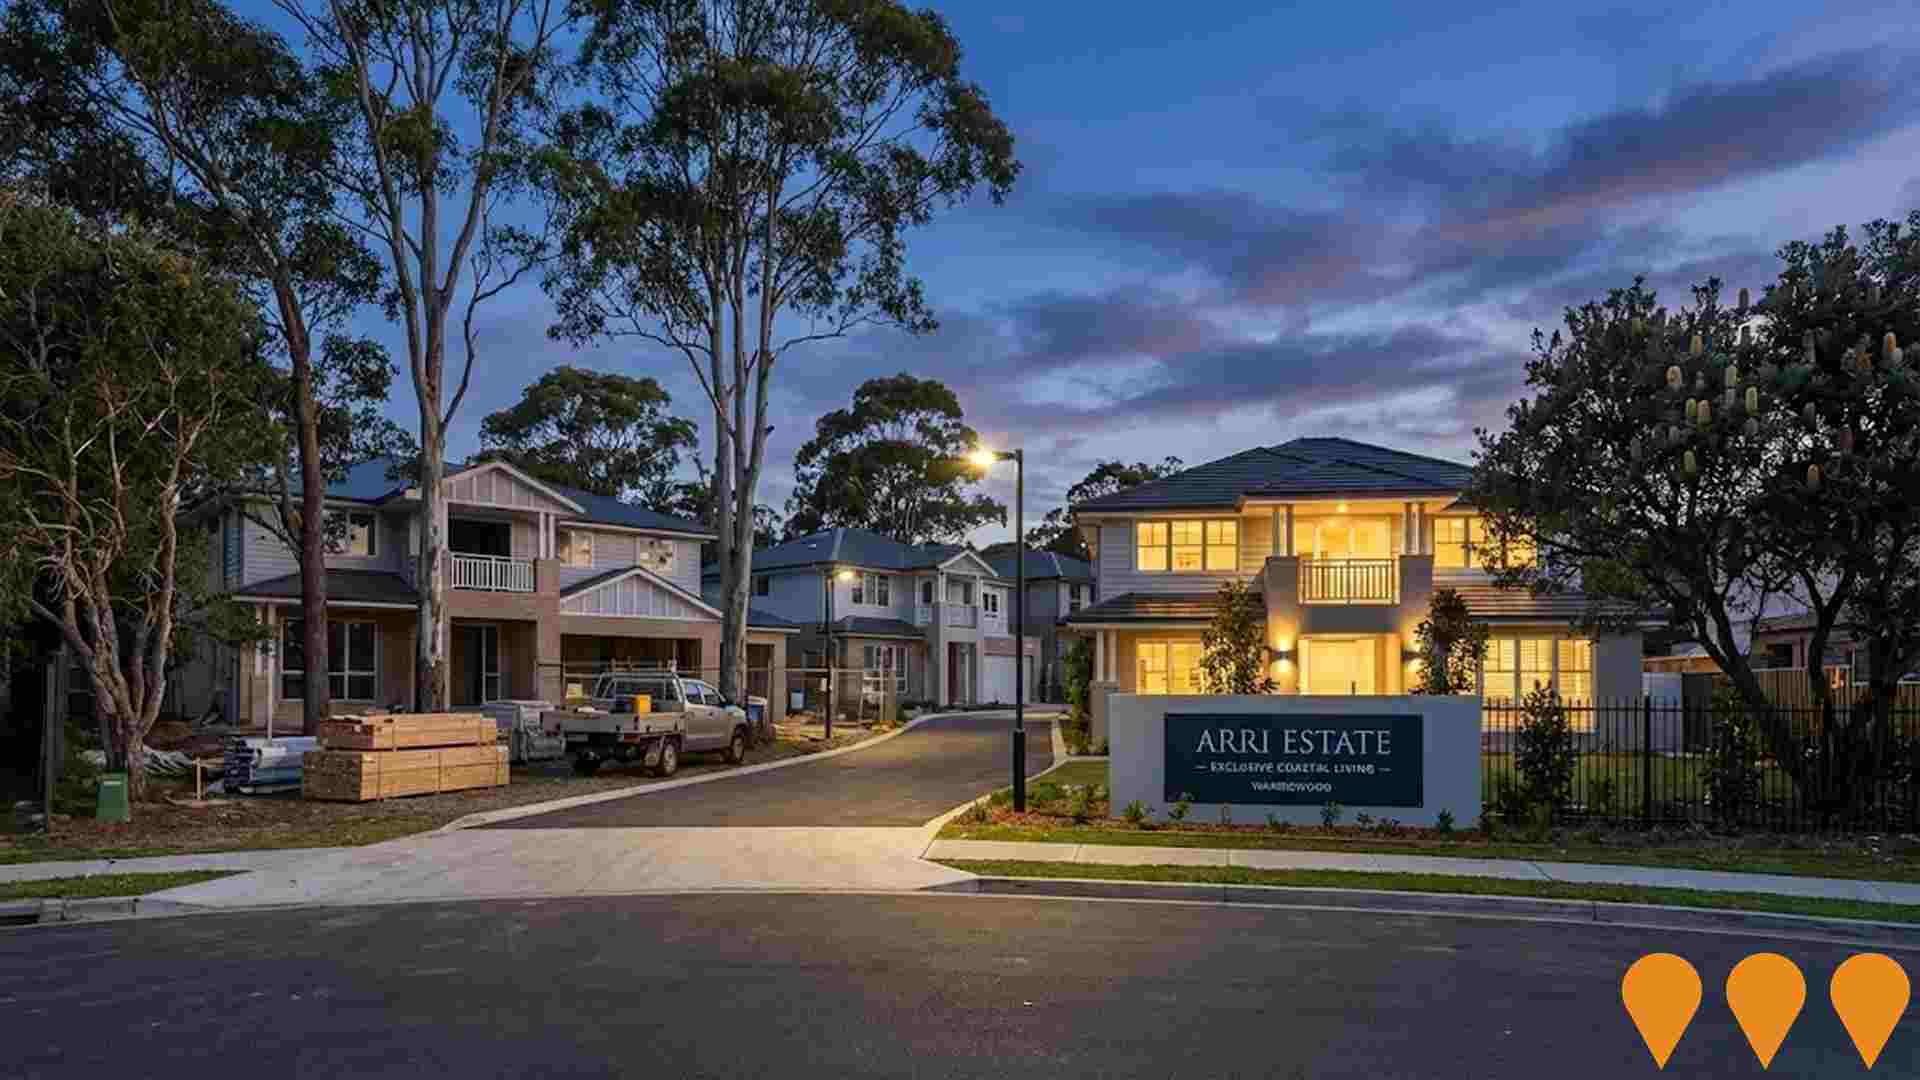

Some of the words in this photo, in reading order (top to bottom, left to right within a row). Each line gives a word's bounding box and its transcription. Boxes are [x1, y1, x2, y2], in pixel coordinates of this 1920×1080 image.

[1196, 729, 1270, 753] ARRI
[1283, 729, 1392, 755] ESTATE
[1333, 763, 1375, 775] LIVING
